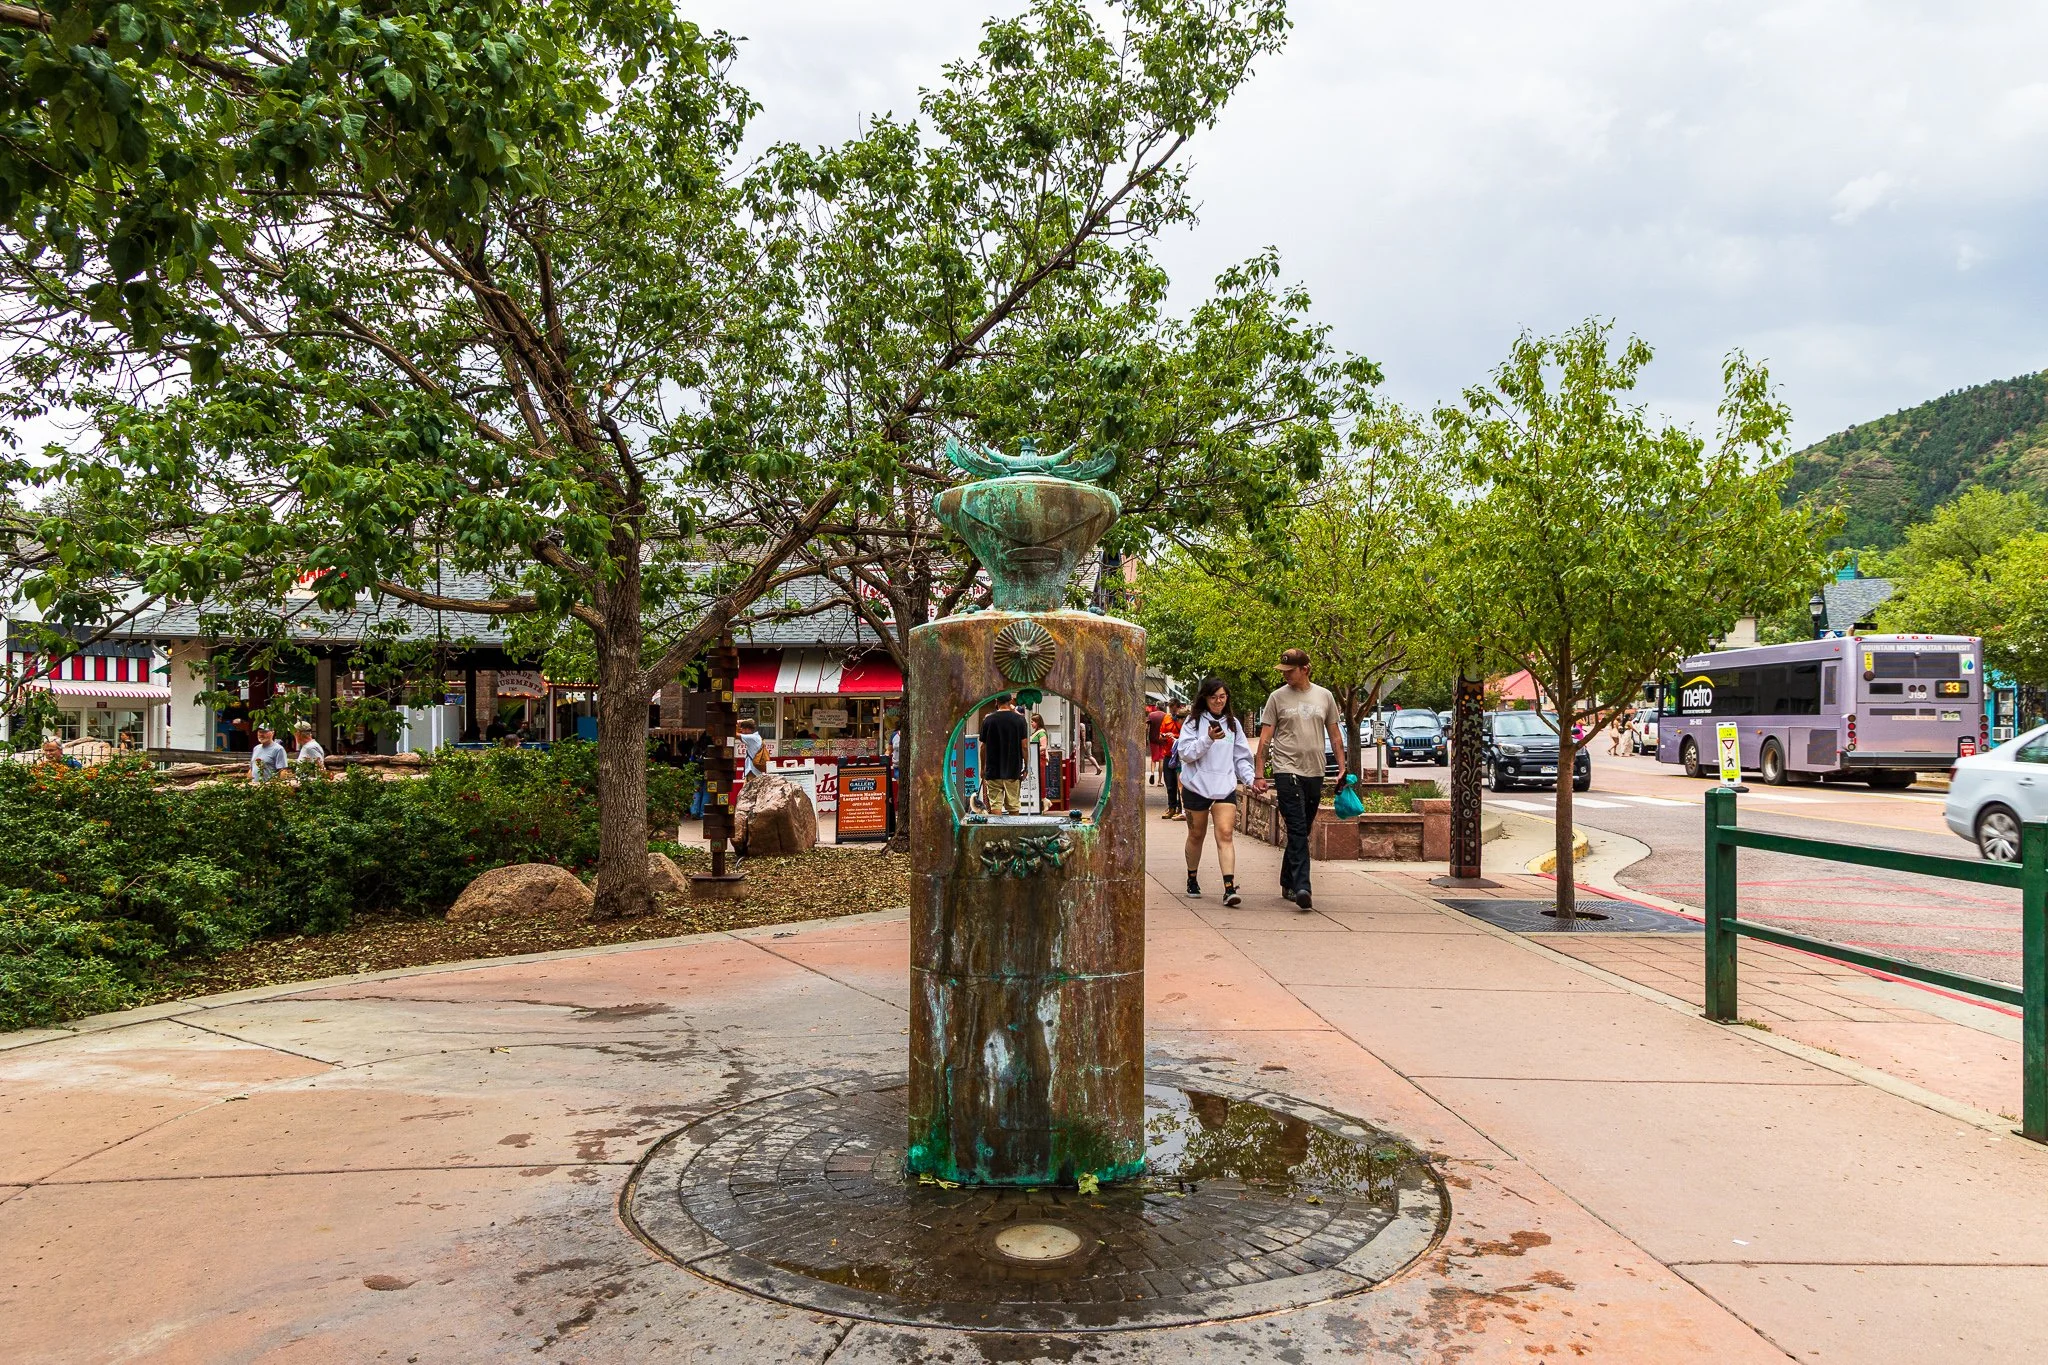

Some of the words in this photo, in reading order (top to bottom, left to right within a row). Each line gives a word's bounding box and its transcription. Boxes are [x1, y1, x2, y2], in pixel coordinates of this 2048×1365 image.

[500, 670, 532, 680] ARCADE
[498, 679, 543, 693] USEMENTS
[1945, 682, 1960, 693] 33
[1682, 684, 1713, 707] metro
